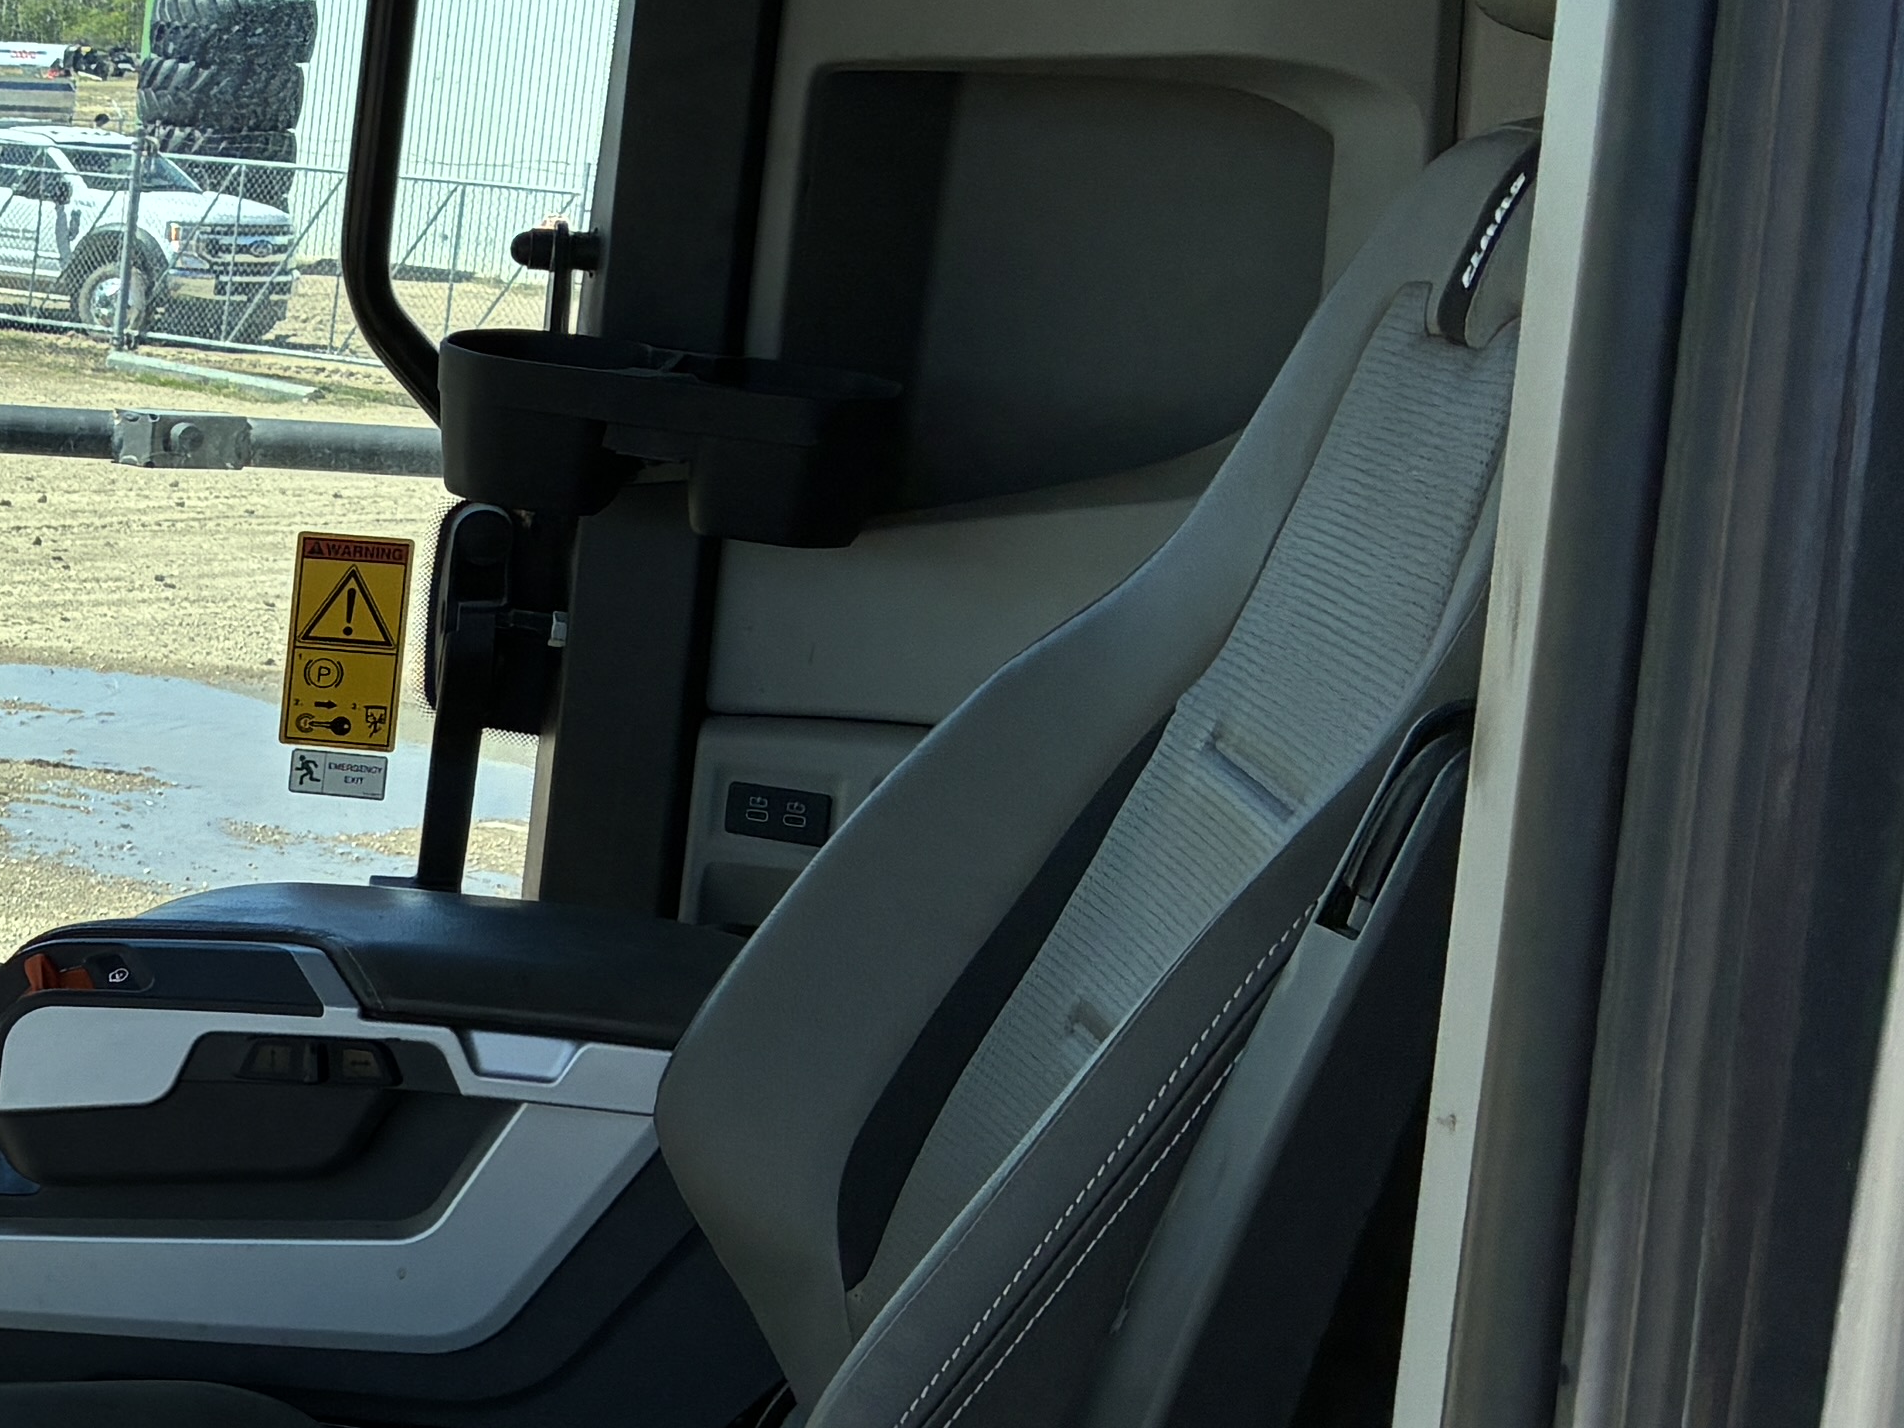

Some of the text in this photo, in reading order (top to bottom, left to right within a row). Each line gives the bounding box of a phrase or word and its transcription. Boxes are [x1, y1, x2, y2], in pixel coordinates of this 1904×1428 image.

[327, 542, 403, 561] WARNING
[328, 762, 383, 774] EMERGENCY
[344, 775, 364, 785] EXIT
